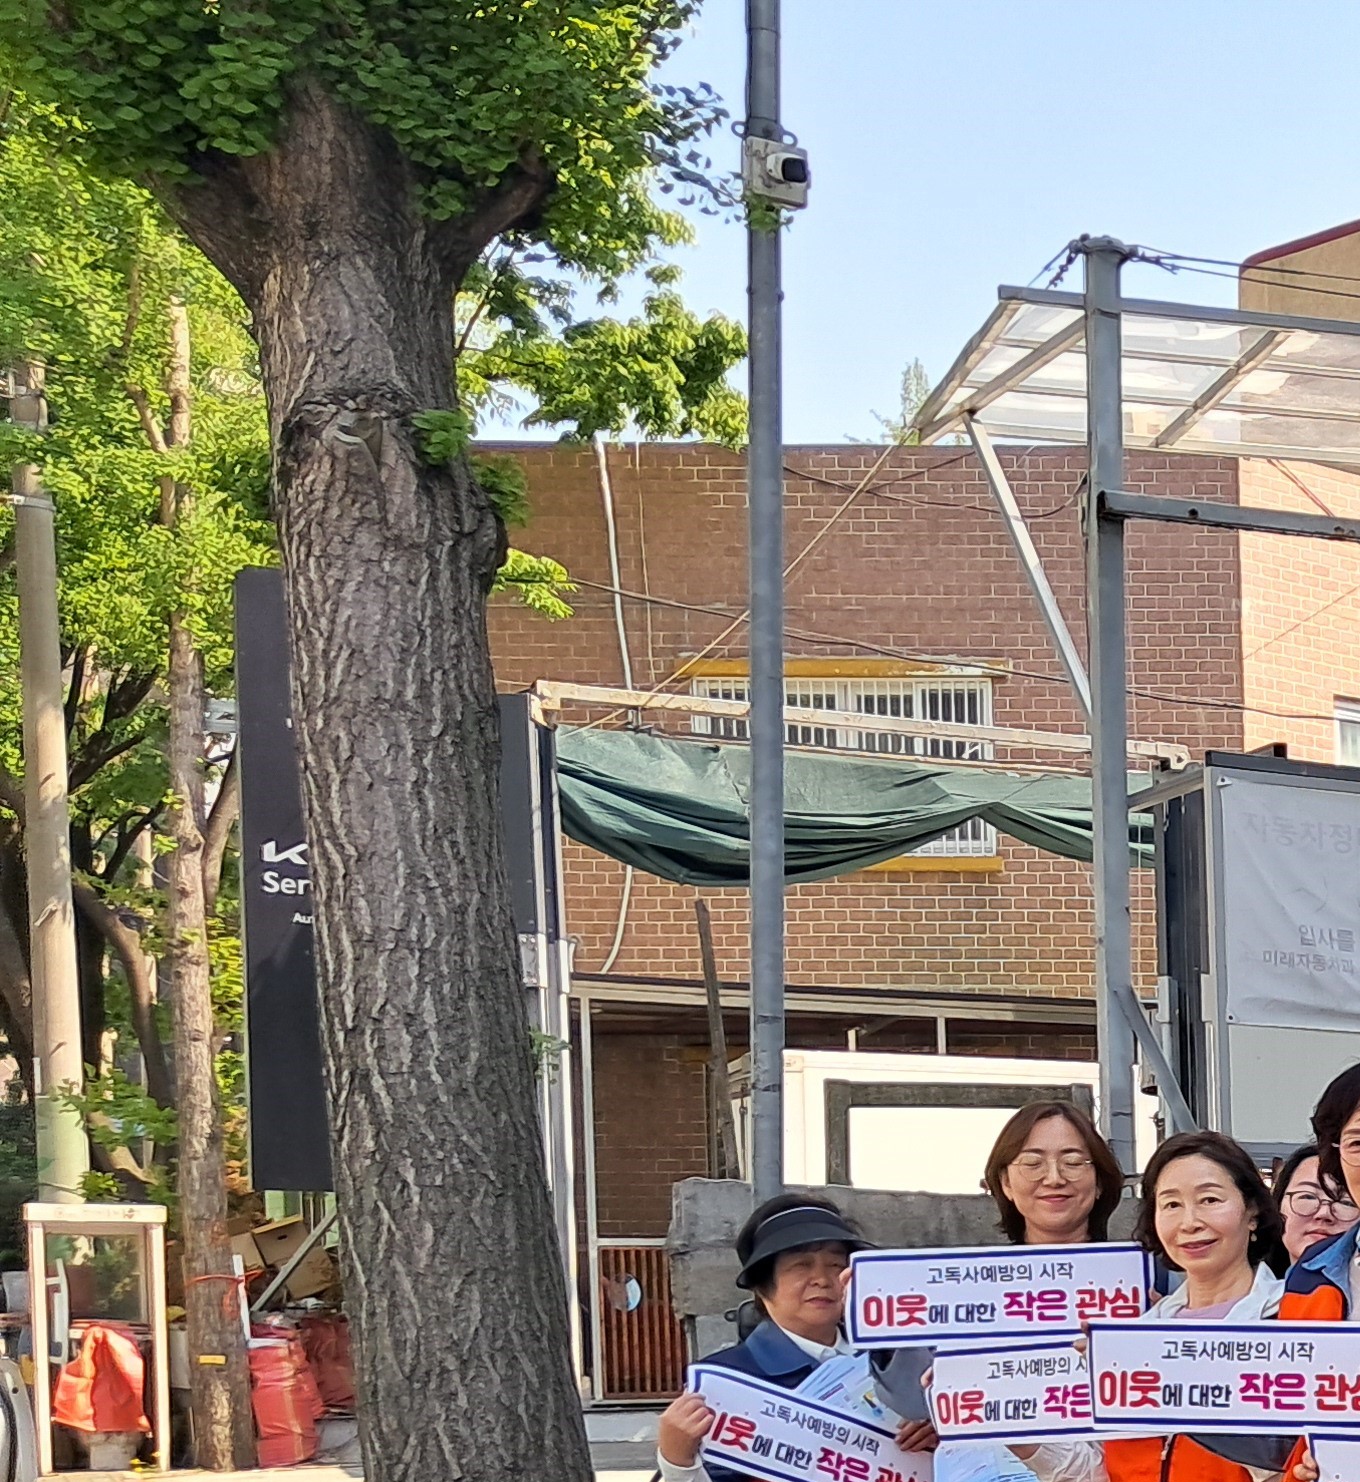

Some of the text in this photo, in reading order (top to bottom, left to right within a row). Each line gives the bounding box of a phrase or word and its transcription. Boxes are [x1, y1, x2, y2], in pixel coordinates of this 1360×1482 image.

[1299, 925, 1355, 953] 입사를
[927, 1260, 1074, 1286] 고독사예방의 시작
[863, 1286, 1141, 1328] 이웃에 대한 작은 관심
[1161, 1339, 1314, 1364] 고독사예방의 시작
[987, 1357, 1071, 1380] 고독사예방의
[1098, 1369, 1183, 1409] 이웃에
[1187, 1382, 1231, 1408] 대한
[1239, 1375, 1306, 1411] 작은
[936, 1388, 1000, 1426] 이웃에
[1003, 1398, 1037, 1421] 대한
[761, 1399, 880, 1457] 고독사예방의 시작
[776, 1441, 813, 1471] 대한
